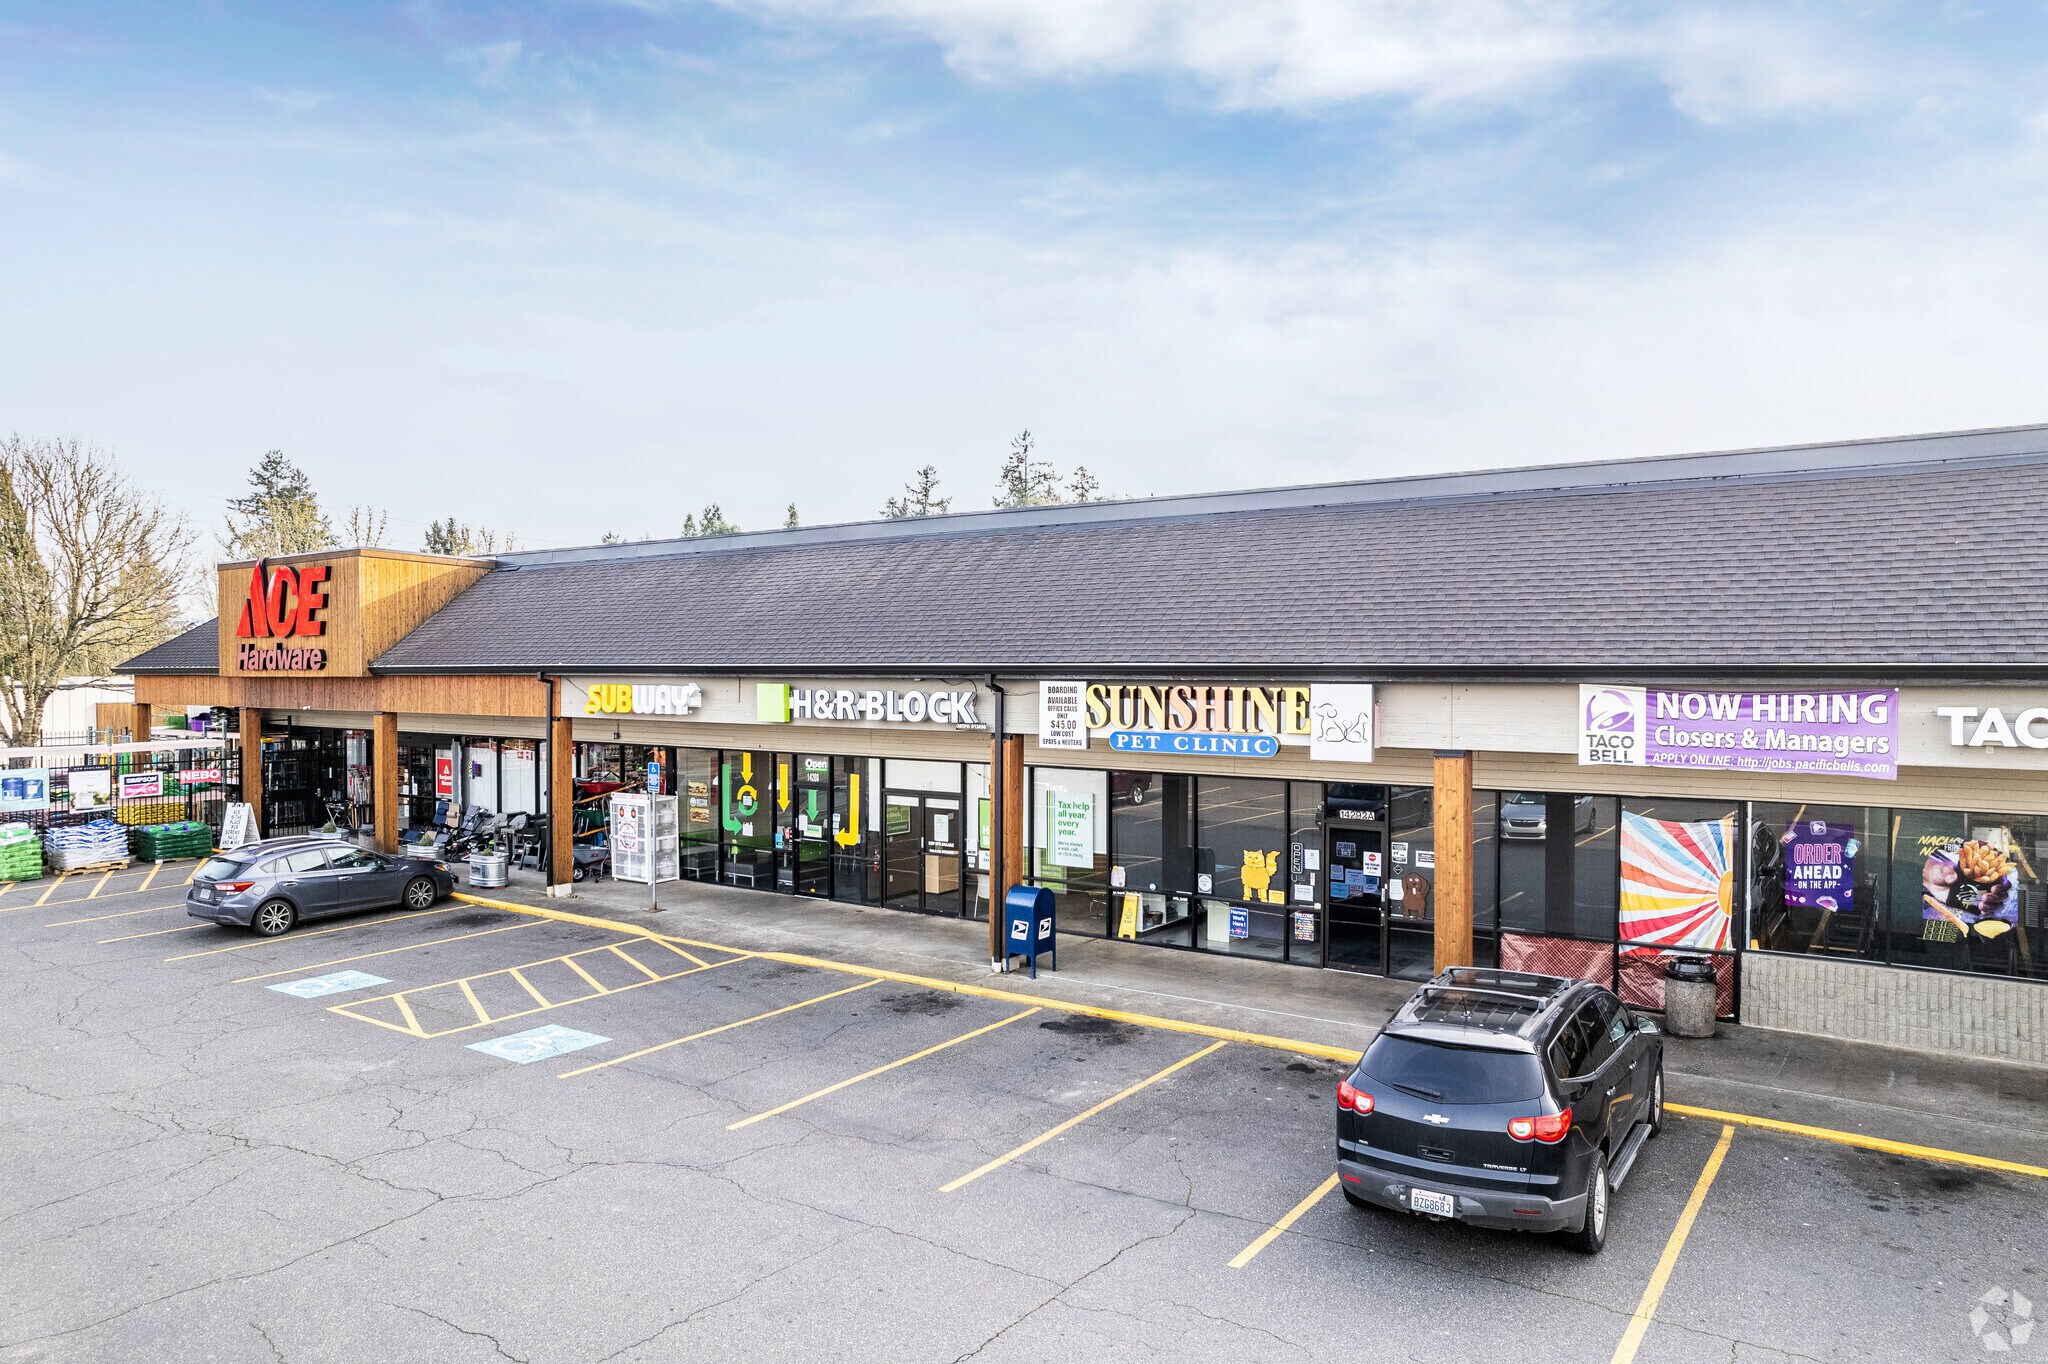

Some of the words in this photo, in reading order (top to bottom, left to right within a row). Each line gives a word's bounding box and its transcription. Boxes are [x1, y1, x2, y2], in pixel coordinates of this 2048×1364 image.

[236, 557, 331, 637] ACE
[237, 643, 325, 670] Hardware
[1048, 686, 1078, 694] BOARDING
[584, 683, 701, 715] SUBWAY
[793, 689, 859, 720] H&R
[866, 690, 977, 723] BLOCK
[1085, 684, 1310, 734] SUNSHINE
[1656, 692, 1742, 721] NOW
[1752, 694, 1888, 724] HIRING
[1050, 720, 1076, 730] $45.00
[1116, 734, 1160, 749] PET
[1174, 736, 1272, 754] CLINIC
[1586, 734, 1634, 749] TACO
[1654, 724, 1736, 749] Closers
[1740, 728, 1760, 750] &
[1764, 728, 1890, 758] Managers
[805, 758, 827, 770] Open
[1590, 750, 1634, 764] BELL
[1652, 752, 1689, 765] APPLY
[1690, 754, 1734, 766] ONLINE:
[1737, 756, 1890, 773] http://jobs.pacificbells.com
[126, 776, 158, 784] SIMPSON
[181, 770, 220, 780] NEBO
[1058, 801, 1071, 809] Tax
[1072, 802, 1090, 811] help
[1068, 812, 1087, 820] year,
[1794, 843, 1842, 864] ORDER
[1794, 866, 1842, 879] AHEAD
[1414, 1197, 1451, 1213] BZG8683
